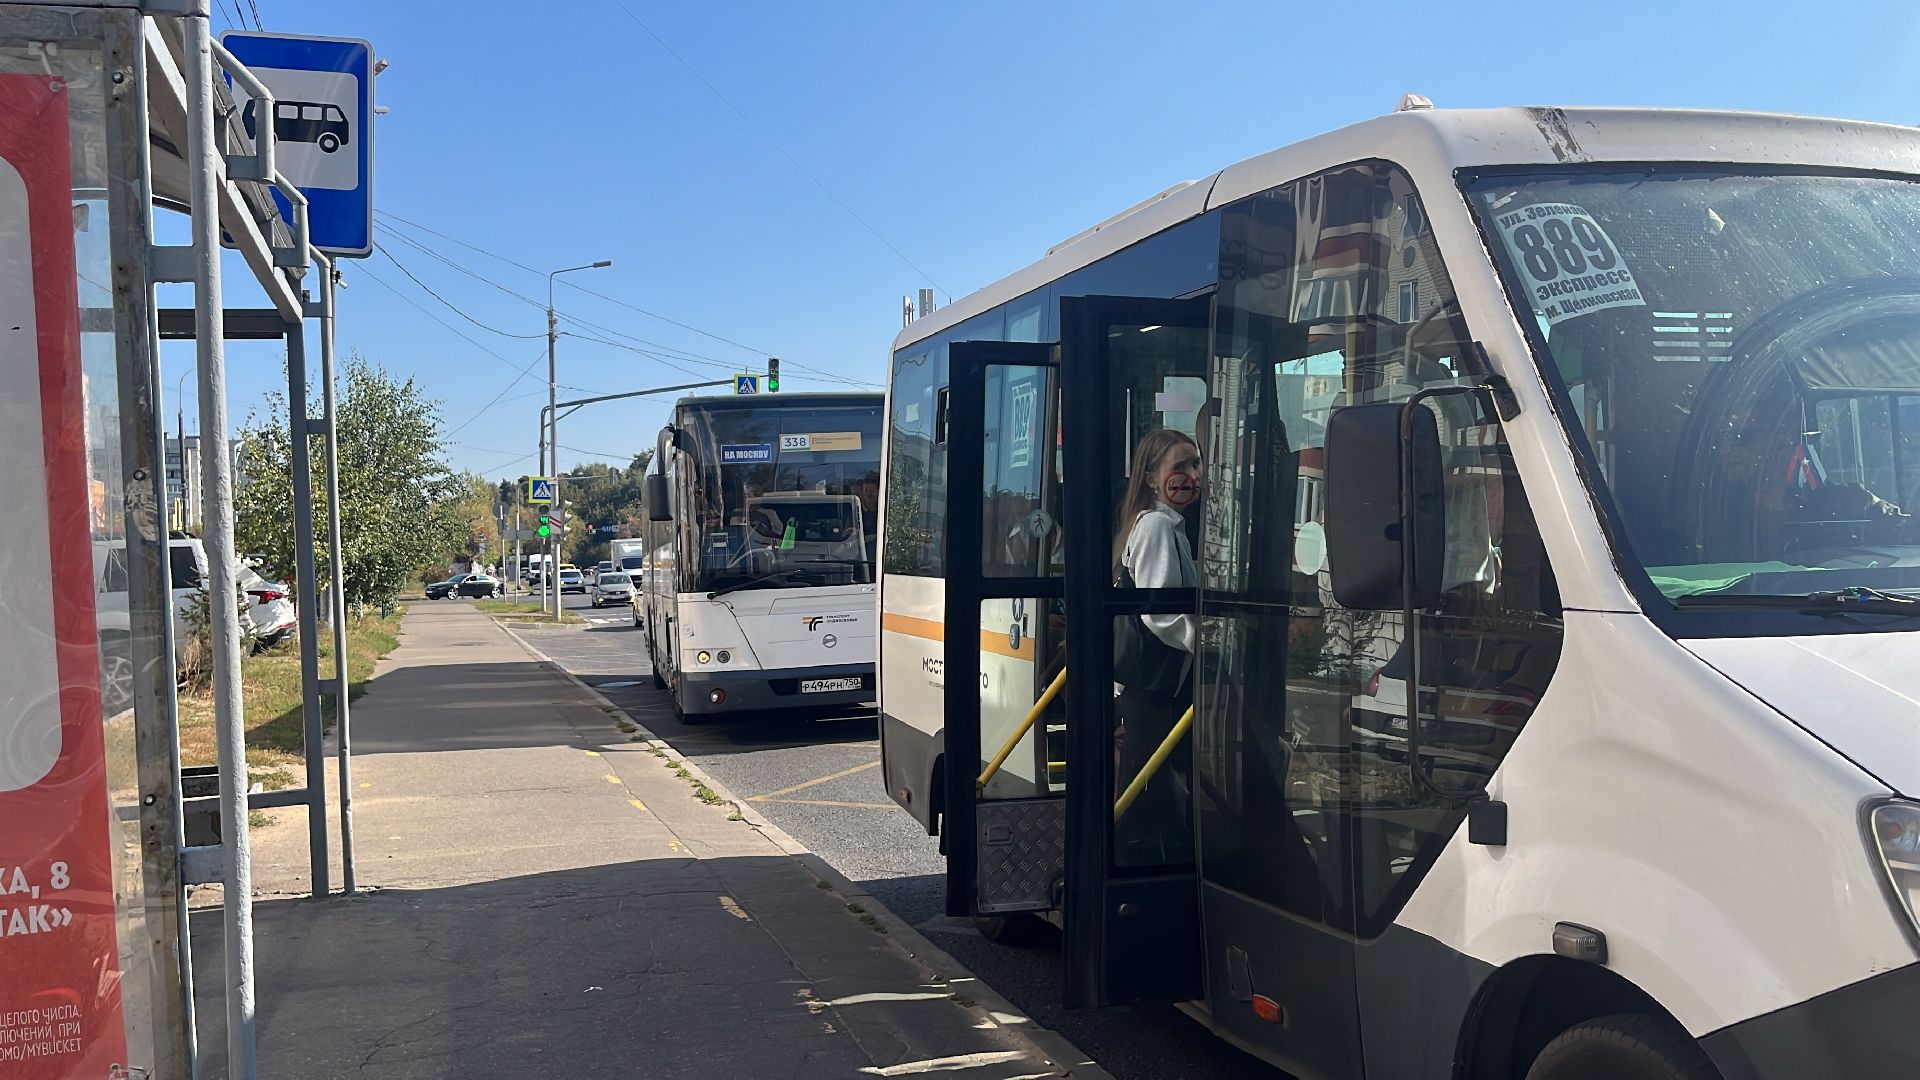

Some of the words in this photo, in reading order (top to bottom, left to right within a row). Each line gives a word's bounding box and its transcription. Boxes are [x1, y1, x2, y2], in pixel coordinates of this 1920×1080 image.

[1500, 214, 1526, 230] ул.
[1513, 216, 1616, 281] 889
[784, 437, 807, 447] 338
[724, 451, 735, 460] НА
[736, 449, 769, 459] МОСКВУ
[843, 678, 859, 686] 750
[50, 861, 71, 890] 8
[58, 1021, 81, 1038] ПРИ
